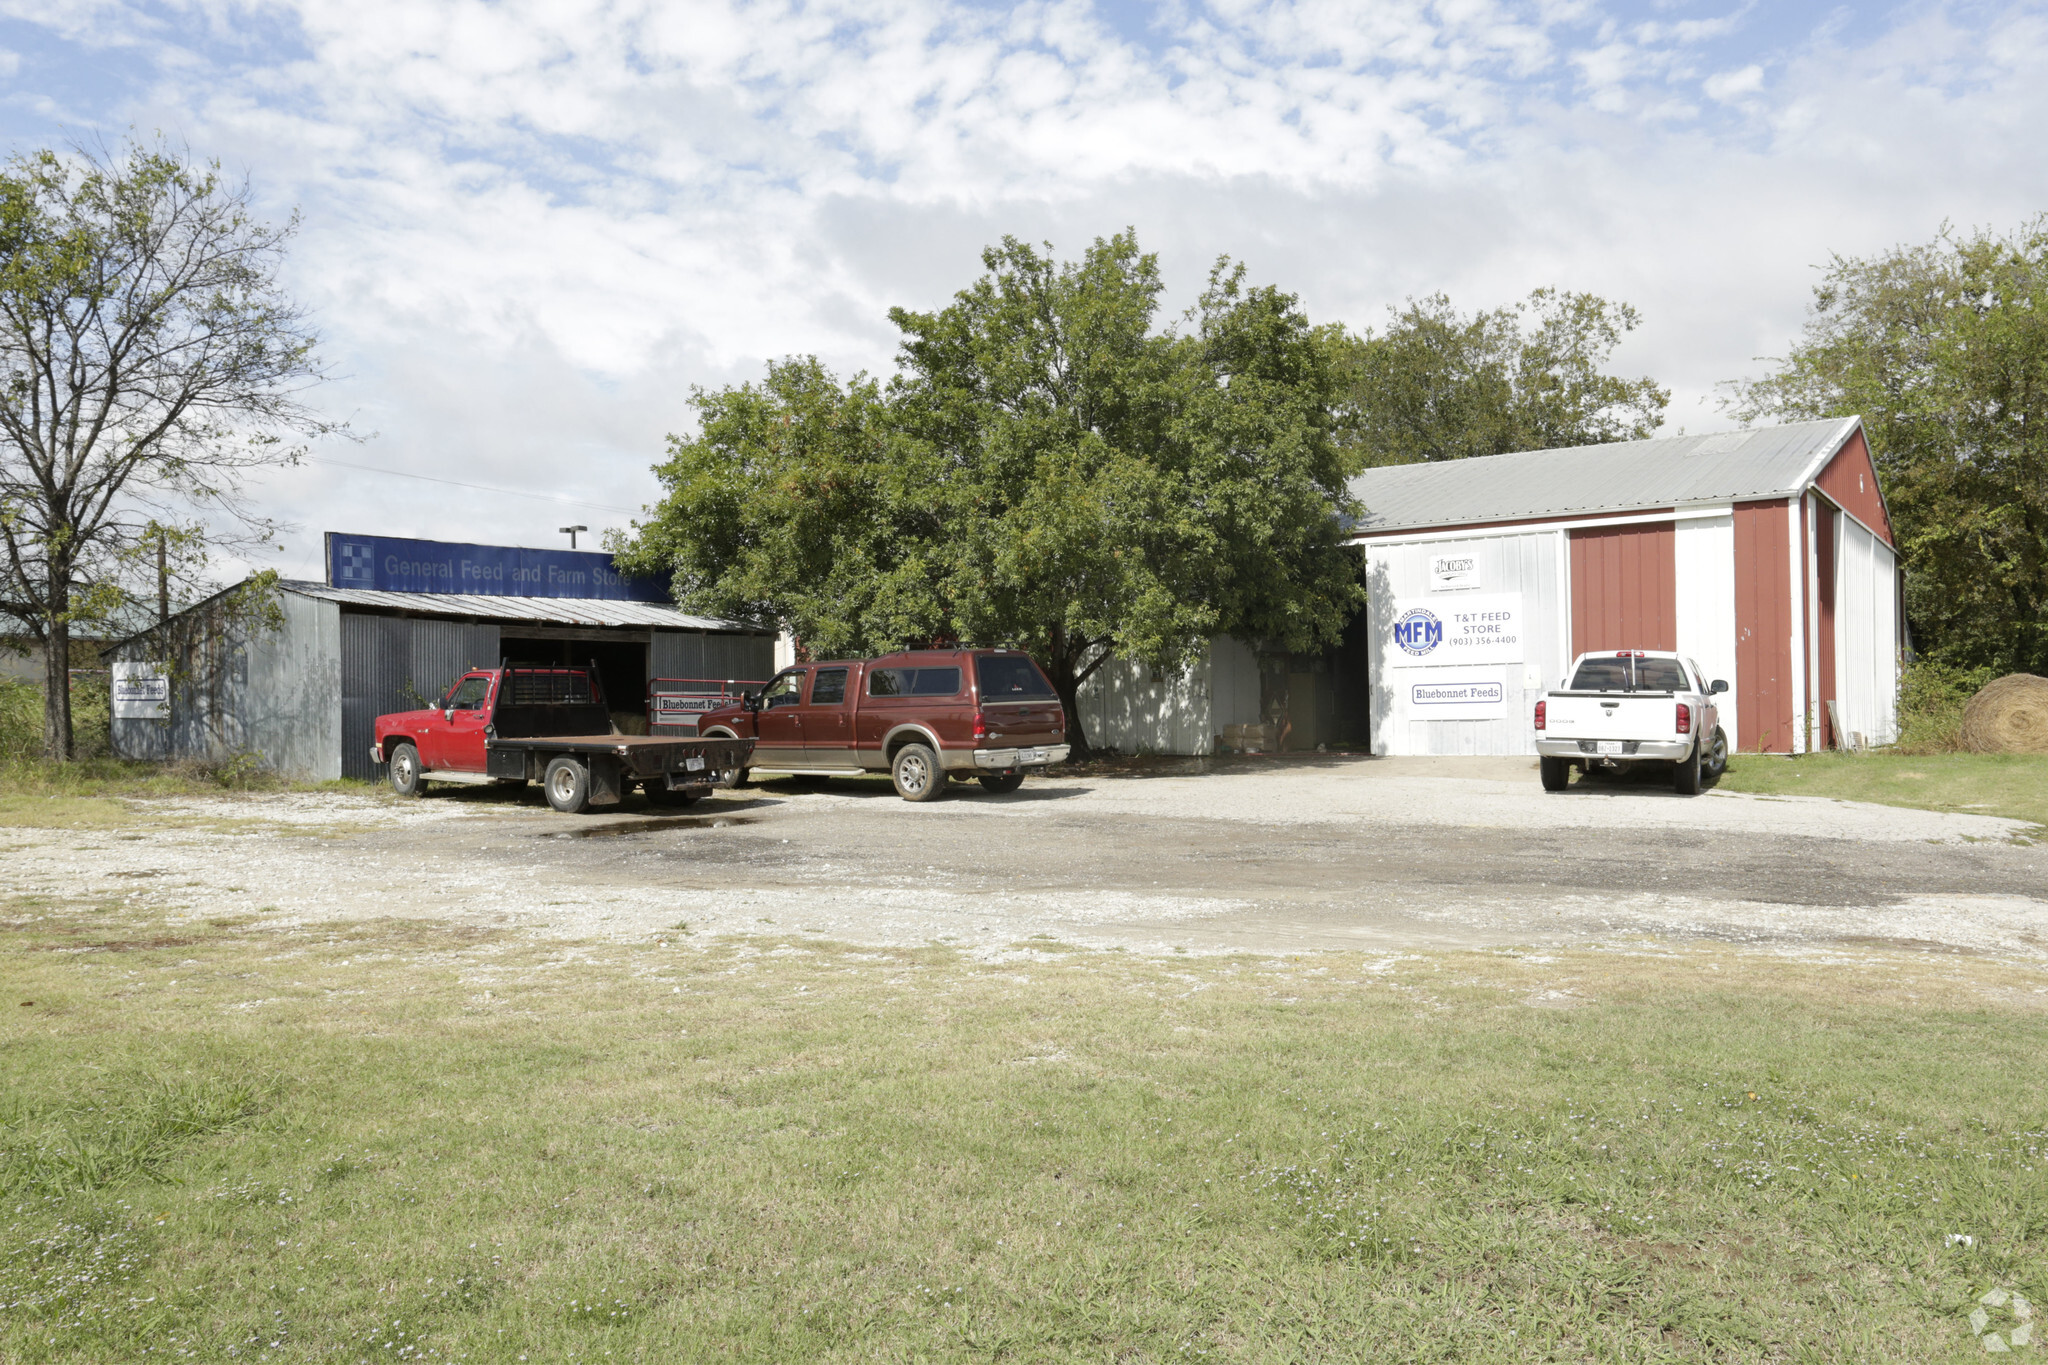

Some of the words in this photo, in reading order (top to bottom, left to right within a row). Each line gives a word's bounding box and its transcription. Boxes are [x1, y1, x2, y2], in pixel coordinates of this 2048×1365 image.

[385, 554, 454, 578] General
[461, 559, 503, 580] Feed
[512, 564, 541, 582] and
[548, 565, 586, 584] Farm
[592, 567, 632, 586] Store
[1453, 613, 1478, 623] T&T
[1481, 611, 1511, 621] FEED
[1394, 620, 1443, 644] MFM
[1463, 624, 1501, 634] STORE
[1449, 636, 1473, 647] (903)
[1476, 635, 1517, 645] 356-4400
[146, 684, 163, 695] Feeds
[1415, 689, 1468, 699] Bluebonnet
[1470, 687, 1499, 698] Feeds
[662, 700, 705, 709] Bluebonnet
[707, 700, 728, 709] Fees
